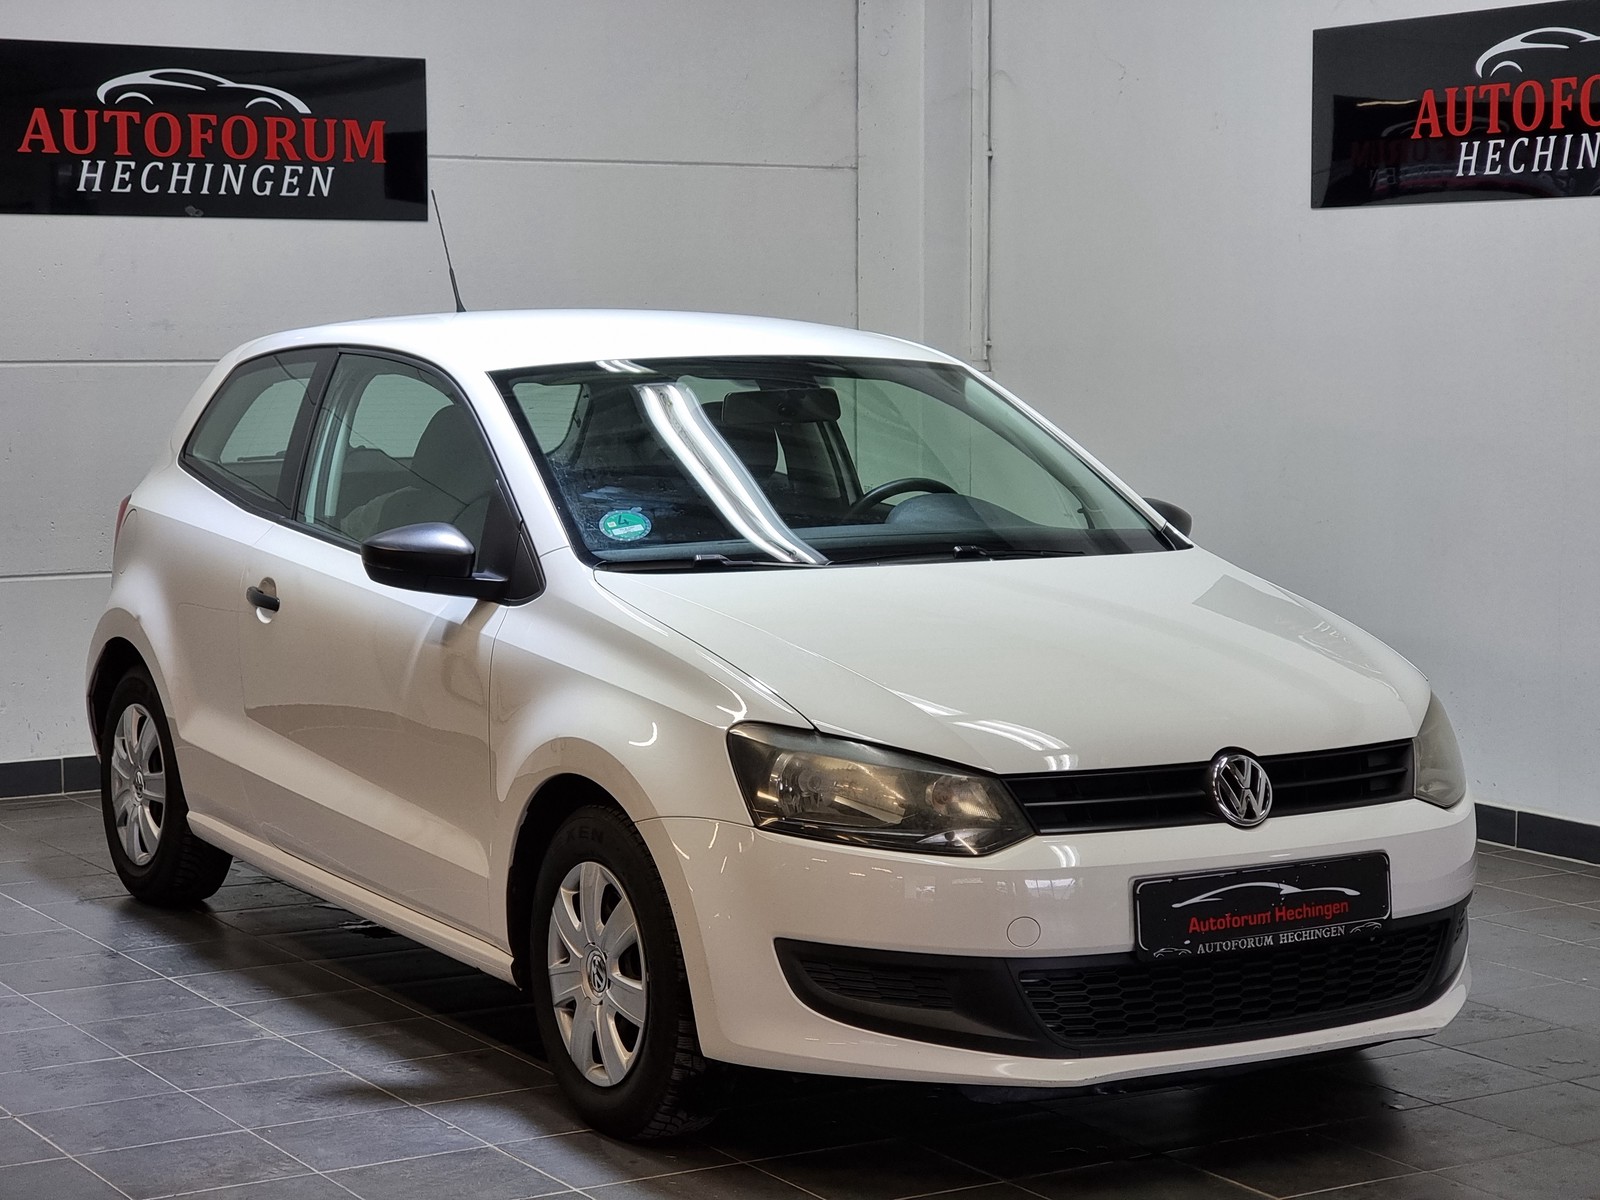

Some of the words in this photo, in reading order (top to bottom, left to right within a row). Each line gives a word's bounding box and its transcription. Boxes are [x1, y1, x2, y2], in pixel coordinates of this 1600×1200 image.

[17, 107, 387, 163] AUTOFORUM
[1456, 132, 1600, 177] HECHIN
[76, 160, 335, 197] HECHINGEN
[1188, 912, 1271, 933] Autoforum
[1275, 902, 1349, 922] Hechingen
[1197, 935, 1274, 954] AUTOFORUM
[1279, 925, 1345, 944] HECHINGEN
